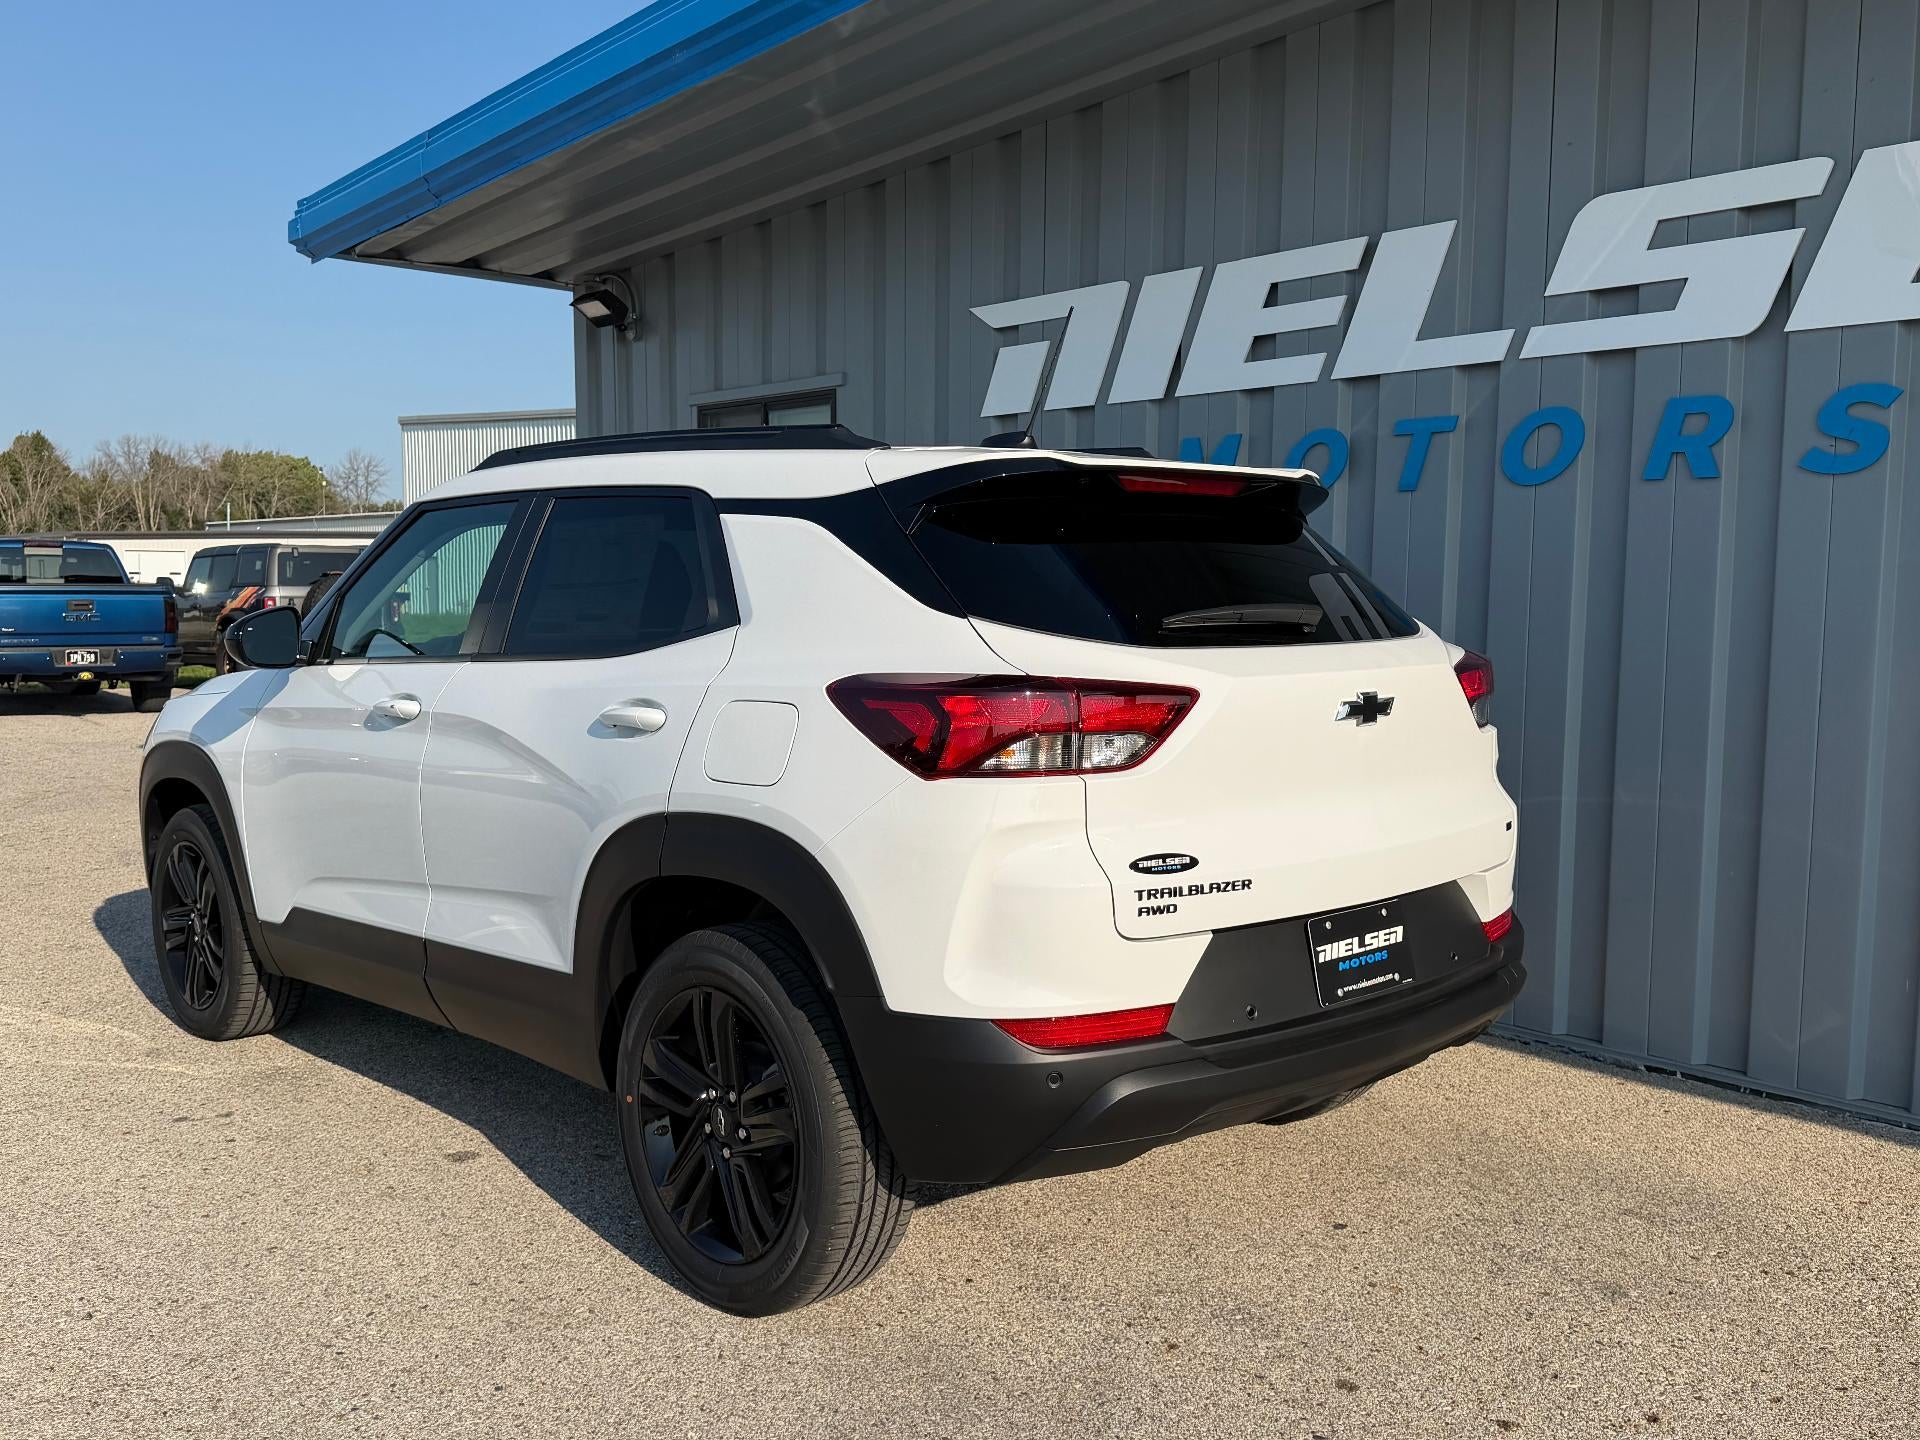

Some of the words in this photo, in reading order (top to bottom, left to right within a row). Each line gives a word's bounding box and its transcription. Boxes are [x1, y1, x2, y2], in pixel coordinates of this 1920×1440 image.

[1136, 856, 1191, 868] NIELSEN
[1134, 879, 1253, 902] TRAILBLAZER
[1137, 904, 1178, 917] AWD
[1316, 925, 1404, 963] NIELSEN
[1338, 949, 1389, 972] MOTORS
